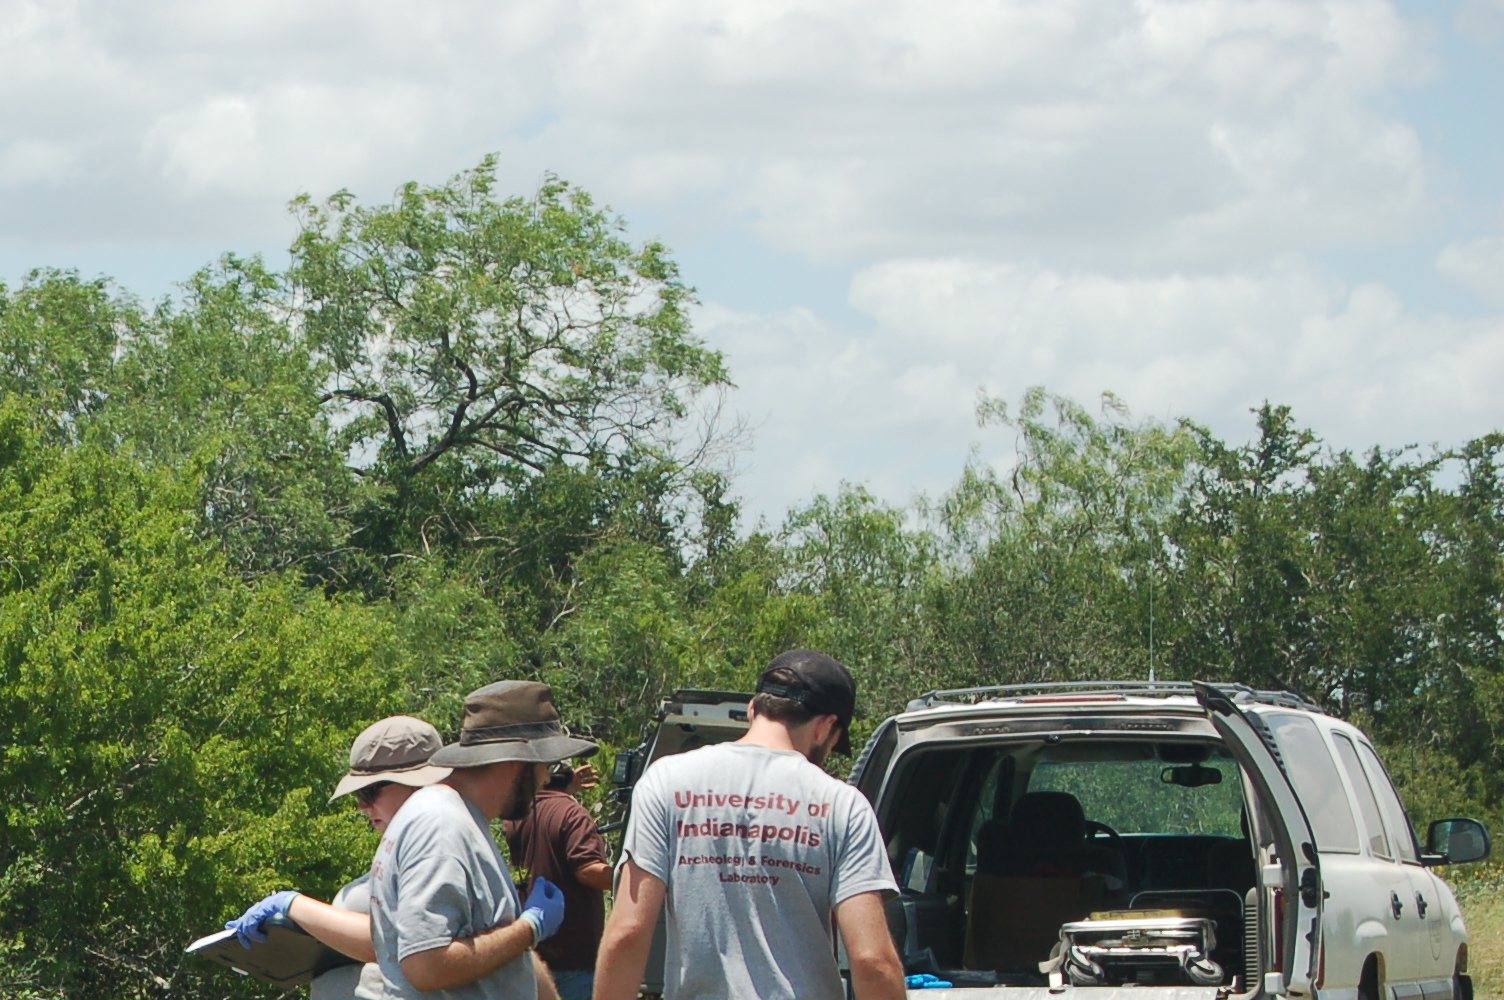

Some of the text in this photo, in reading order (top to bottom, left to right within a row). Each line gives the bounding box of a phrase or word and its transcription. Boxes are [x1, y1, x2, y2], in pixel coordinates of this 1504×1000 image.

[674, 789, 830, 818] University of
[677, 818, 821, 847] Indianapolis
[748, 855, 756, 866] &
